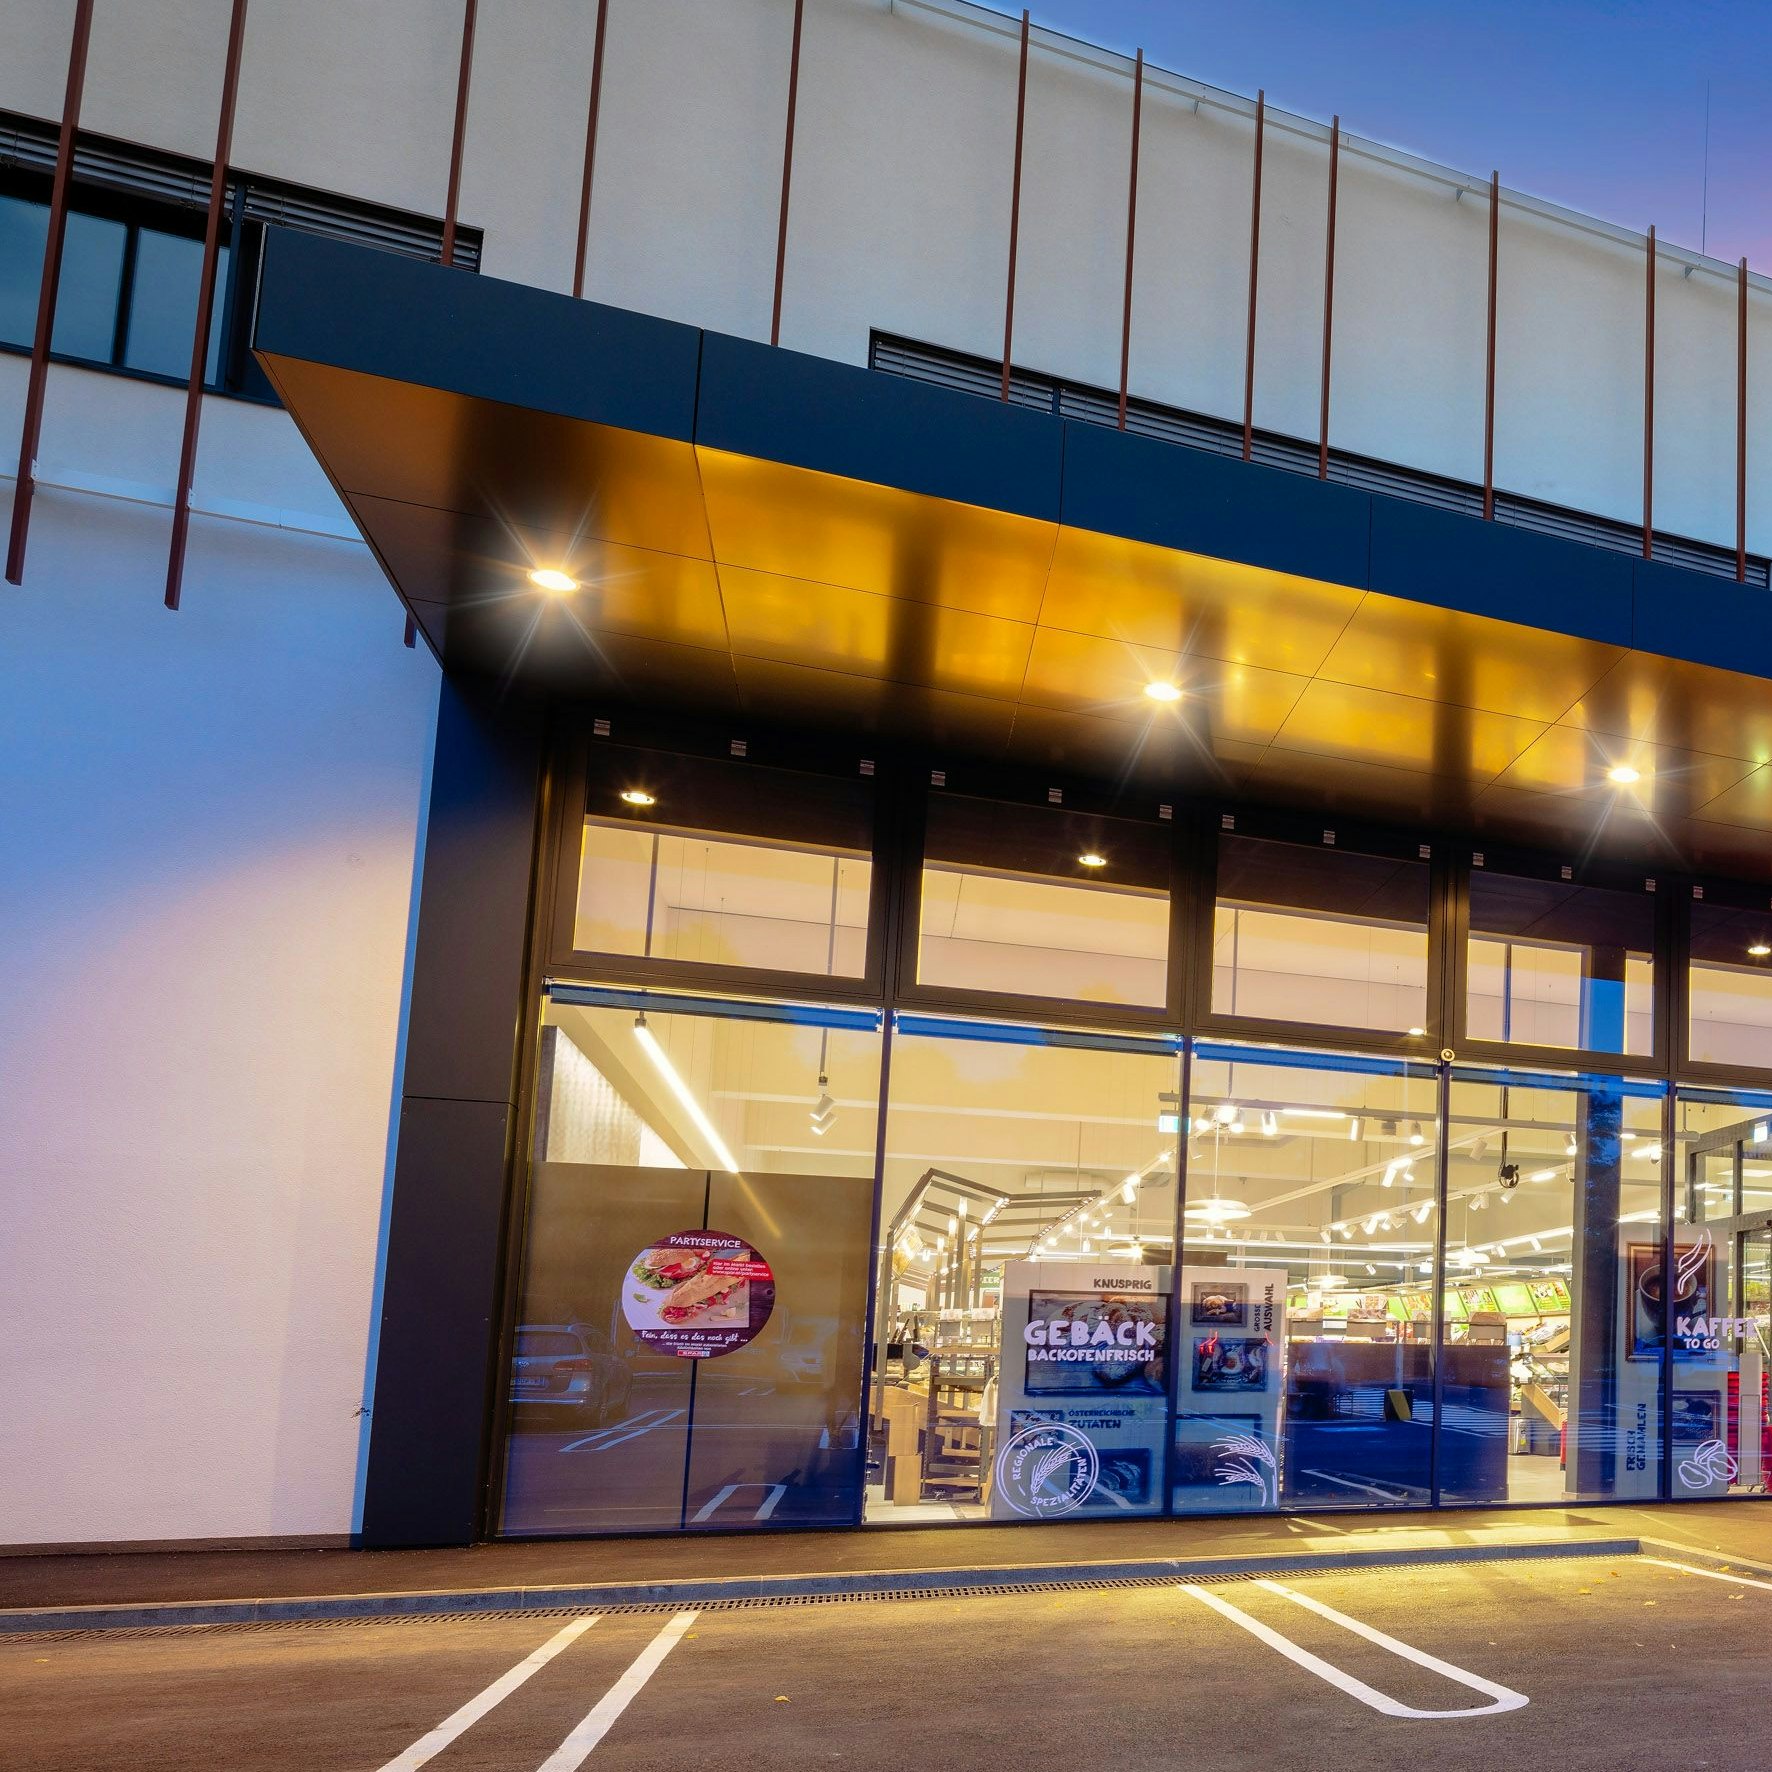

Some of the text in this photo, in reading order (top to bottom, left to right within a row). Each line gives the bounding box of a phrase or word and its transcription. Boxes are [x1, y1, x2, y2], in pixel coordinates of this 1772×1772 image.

[670, 1236, 741, 1248] PARTYSERVICE
[1094, 1278, 1152, 1290] KNUSPRIG
[1263, 1283, 1274, 1332] AUSWAHL
[1023, 1315, 1157, 1346] GEBÄCK
[1676, 1316, 1759, 1338] KAFFEE
[641, 1330, 658, 1340] Fein,
[660, 1331, 678, 1340] dass
[680, 1333, 689, 1341] es
[691, 1332, 705, 1341] das
[707, 1332, 722, 1341] noch
[725, 1332, 740, 1345] gibt
[1683, 1338, 1720, 1350] TO GO
[1028, 1349, 1155, 1362] BACKOFENFRISCH
[1068, 1408, 1136, 1417] ÖSTERREICHISCHE
[1068, 1419, 1121, 1429] ZUTATEN
[1013, 1437, 1055, 1481] REGIONALE
[1030, 1458, 1088, 1507] SPEZIALITÄTEN
